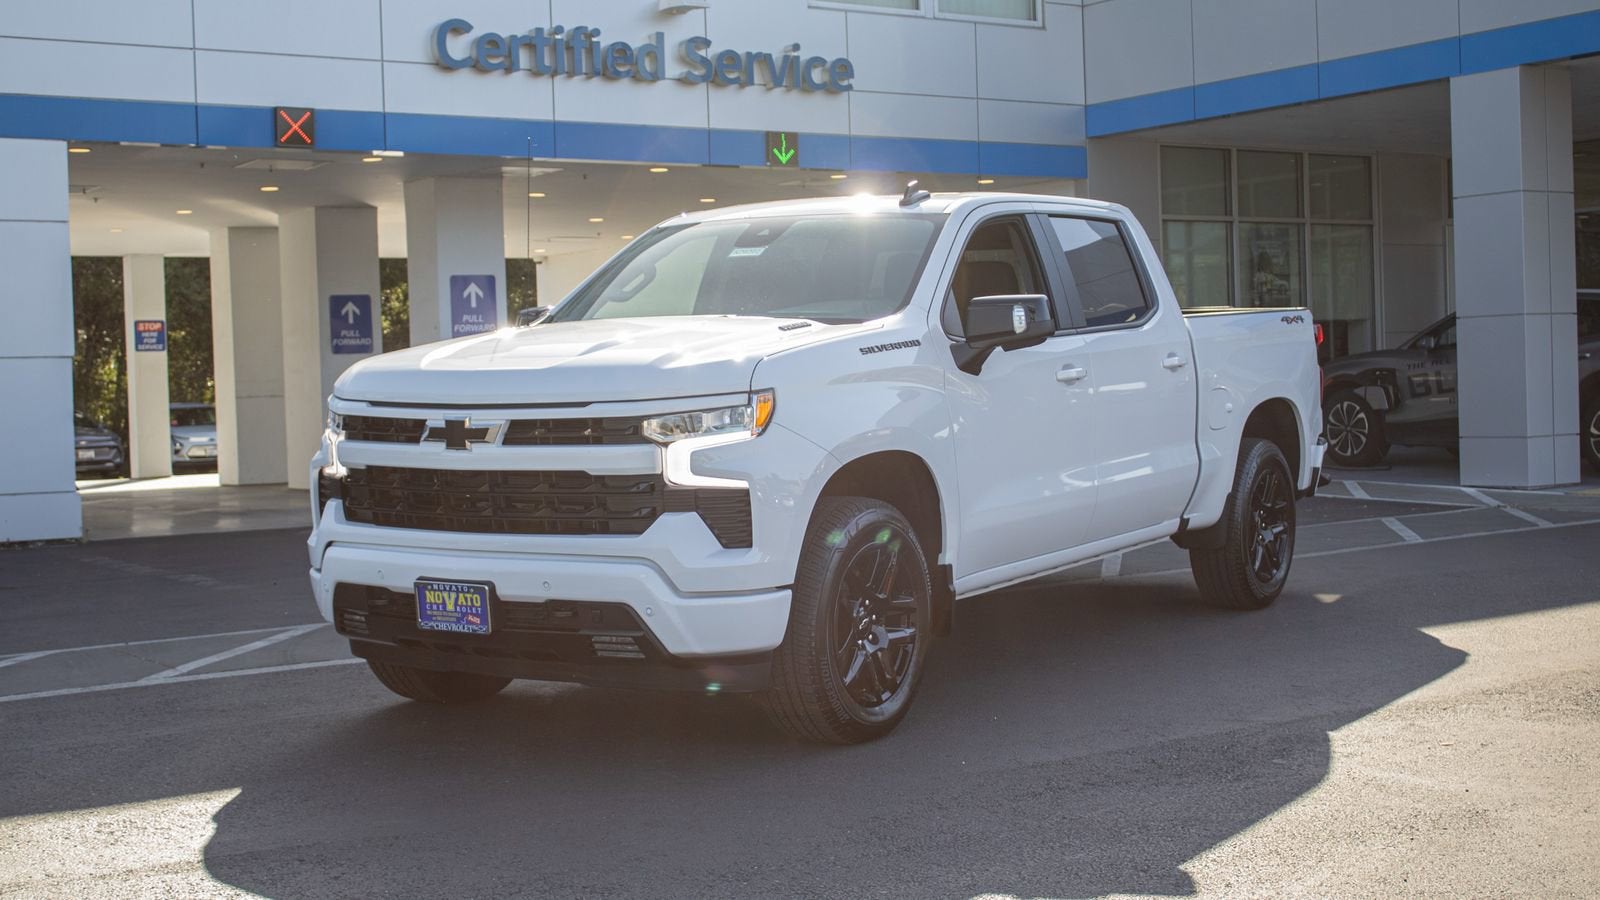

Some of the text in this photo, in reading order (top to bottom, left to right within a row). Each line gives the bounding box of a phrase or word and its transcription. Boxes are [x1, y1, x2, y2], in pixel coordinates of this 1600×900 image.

[432, 18, 856, 94] Certified Service
[462, 314, 484, 323] PULL
[137, 322, 162, 331] STOP
[453, 323, 497, 332] FORWARD
[332, 337, 372, 346] FORWARD
[858, 339, 921, 355] SILVERADO
[432, 584, 468, 592] NOVATO
[425, 591, 481, 611] NOVATO
[433, 622, 473, 632] CHEVROLET
